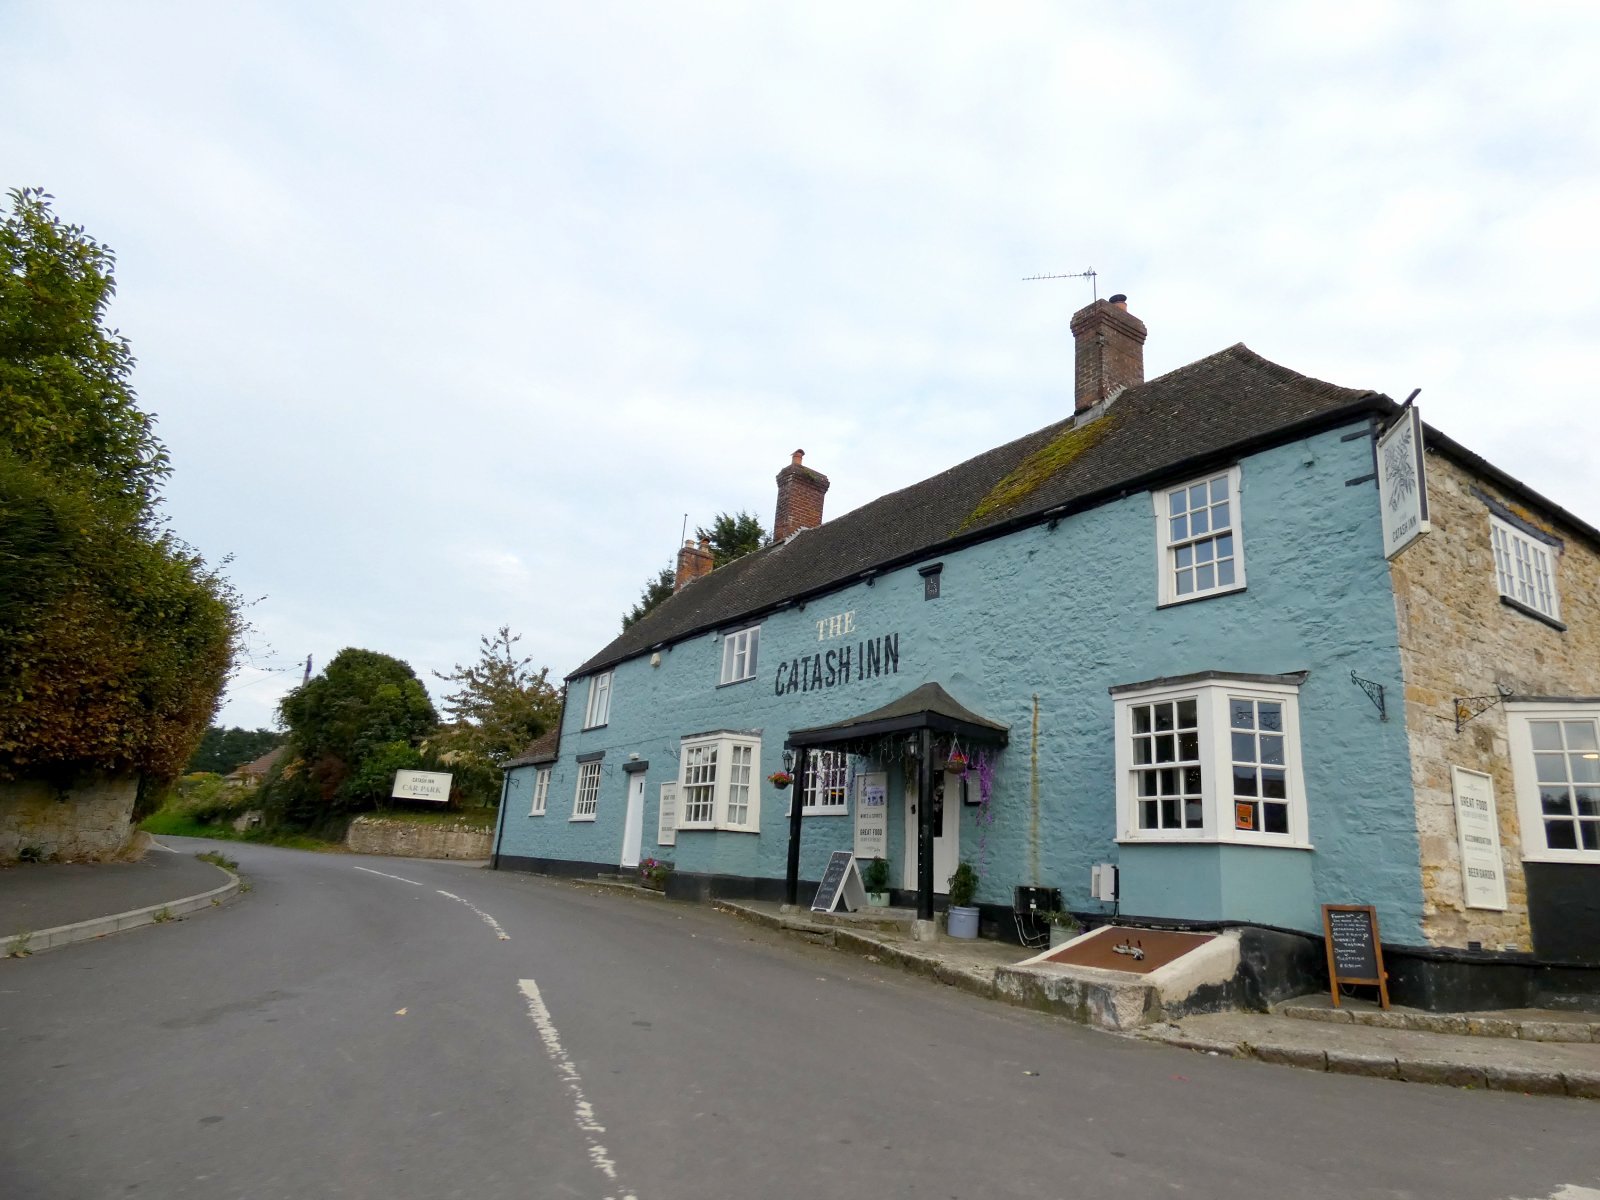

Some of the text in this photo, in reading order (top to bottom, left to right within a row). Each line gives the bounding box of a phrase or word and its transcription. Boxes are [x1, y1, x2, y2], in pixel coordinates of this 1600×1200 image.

[1392, 521, 1408, 543] CATASH
[1408, 514, 1417, 530] INN
[816, 610, 856, 641] THE
[775, 633, 899, 697] CATASH INN
[402, 784, 441, 793] CAR PARK
[1460, 795, 1488, 811] GREAT FOOD
[860, 828, 883, 836] GREAT FOOD
[1465, 834, 1492, 846] ACCOMMODATION
[1468, 866, 1496, 880] BEER GARDEN
